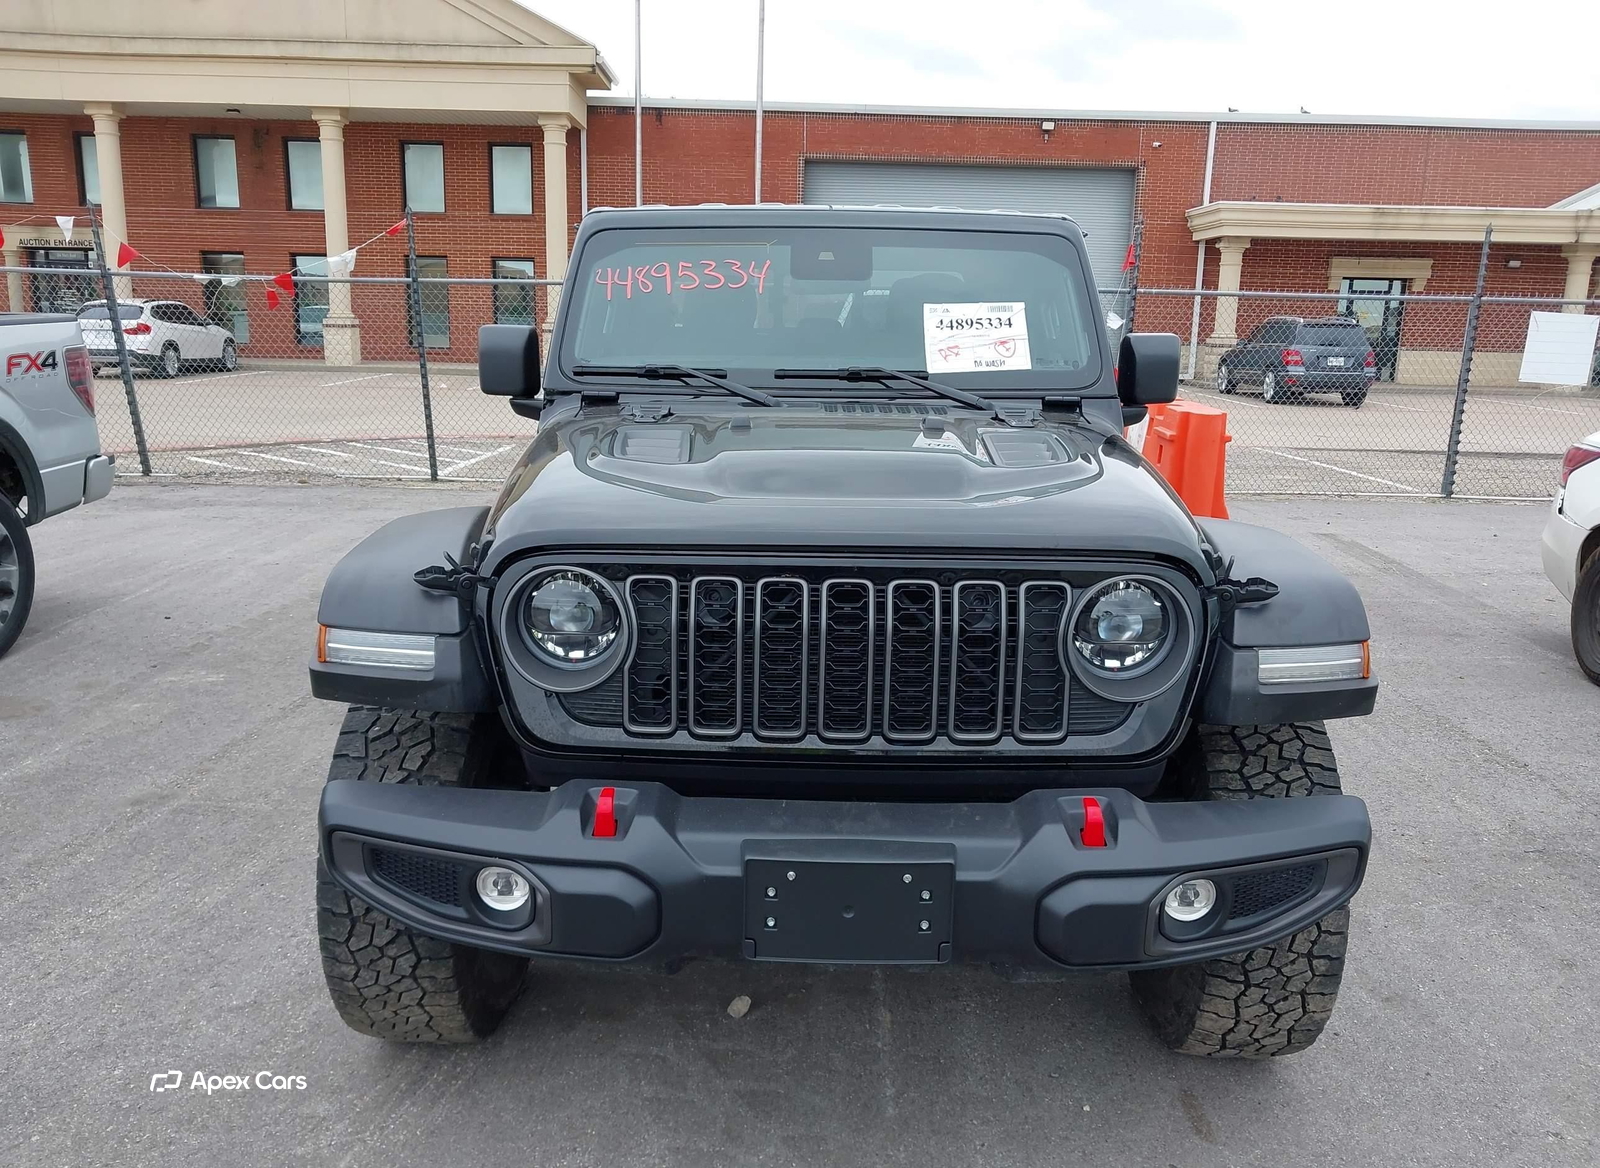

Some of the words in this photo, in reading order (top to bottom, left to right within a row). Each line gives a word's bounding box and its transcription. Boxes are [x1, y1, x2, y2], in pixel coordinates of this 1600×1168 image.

[18, 238, 51, 246] AUCTION
[53, 239, 94, 247] ENTRANCE
[595, 259, 771, 301] 44895334
[935, 317, 1013, 331] 44895334
[6, 350, 58, 377] FX4
